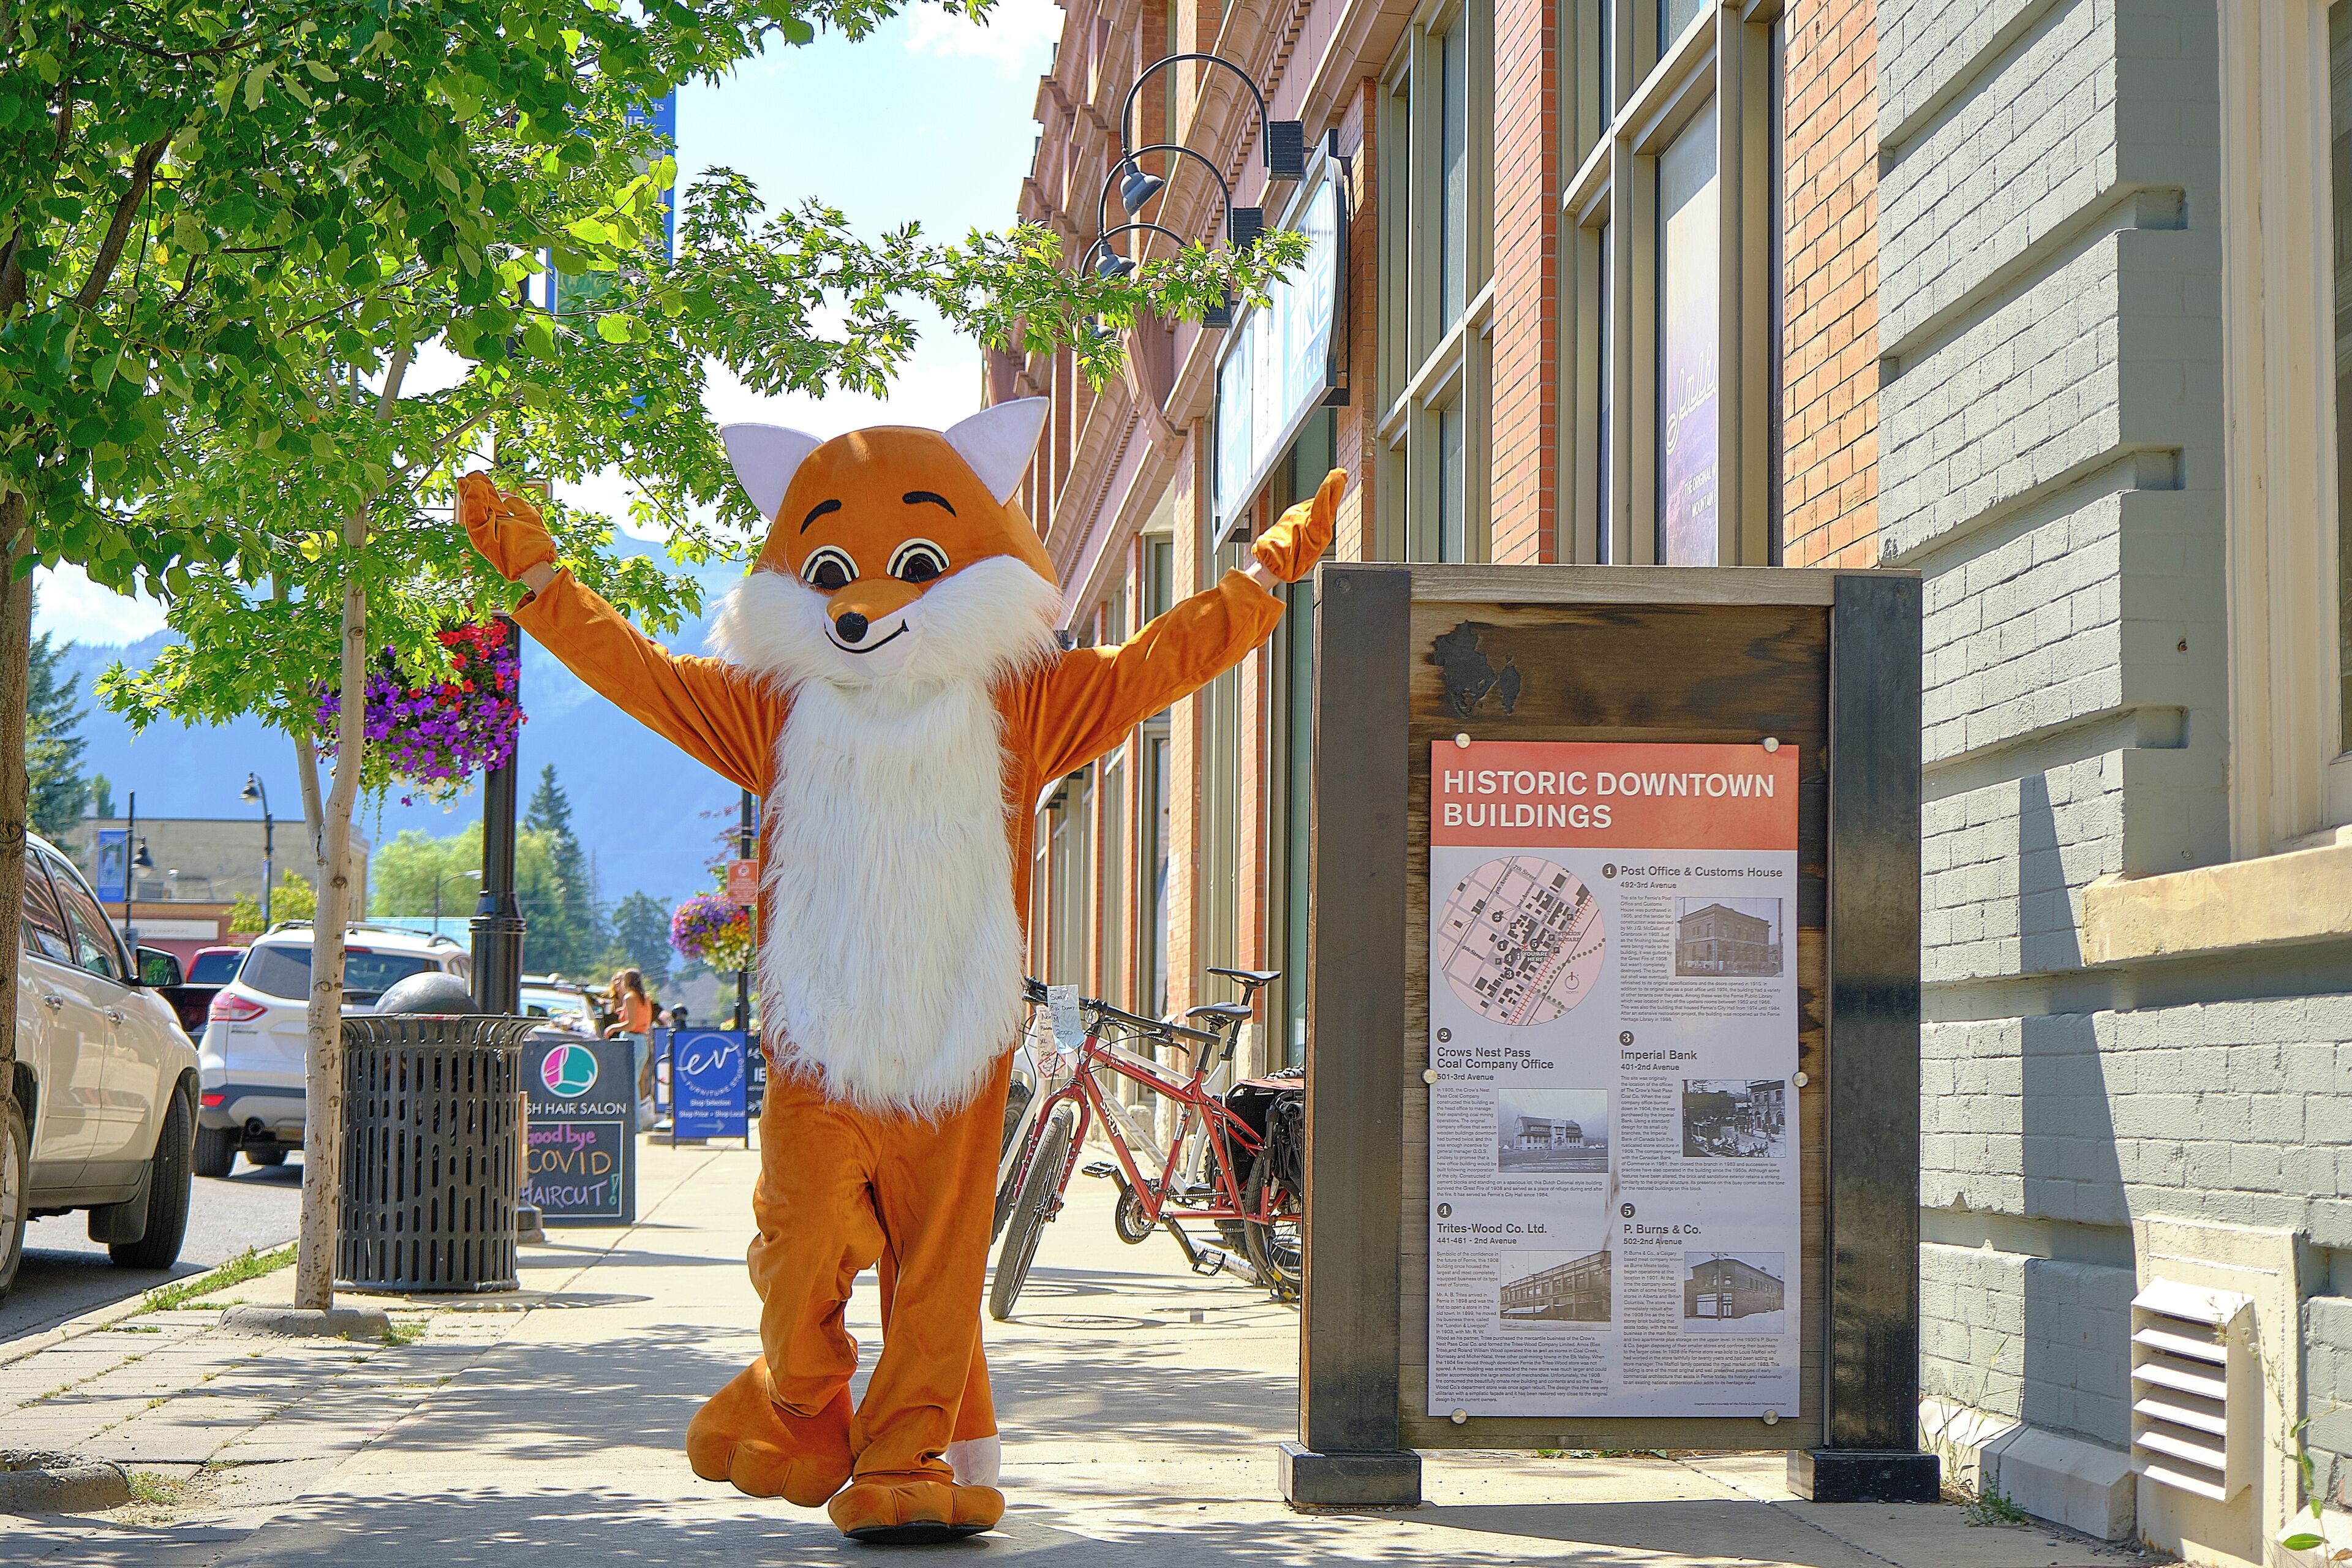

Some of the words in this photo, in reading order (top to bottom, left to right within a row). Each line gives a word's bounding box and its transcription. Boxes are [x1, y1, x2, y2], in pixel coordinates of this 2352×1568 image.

[1684, 480, 1693, 497] THE
[1692, 466, 1711, 492] ORIGINAL
[1691, 490, 1714, 518] MOUNTAIN
[1444, 770, 1588, 795] HISTORIC
[1597, 772, 1774, 797] DOWNTOWN
[1444, 803, 1611, 828] BUILDINGS
[1501, 868, 1513, 885] Avenue
[1523, 869, 1537, 881] Street
[1621, 866, 1645, 876] Post
[1649, 866, 1680, 876] Office
[1684, 867, 1692, 876] &
[1695, 867, 1744, 877] Customs
[1747, 867, 1782, 877] House
[1523, 882, 1535, 899] Avenue
[1547, 897, 1560, 913] Avenue
[1470, 949, 1485, 961] Street
[1437, 1047, 1472, 1057] Crows
[1476, 1047, 1501, 1057] Nest
[1504, 1047, 1531, 1057] Pass
[1621, 1049, 1665, 1061] Imperial
[1669, 1050, 1697, 1060] Bank
[729, 1057, 745, 1088] STUDIO
[1437, 1058, 1462, 1068] Coal
[1465, 1058, 1518, 1071] Company
[1521, 1059, 1554, 1069] Office
[685, 1079, 731, 1096] FURNITURE
[545, 1102, 577, 1115] HAIR
[579, 1102, 627, 1115] SALON
[690, 1099, 705, 1107] Shop
[1099, 1100, 1121, 1138] SURLY
[565, 1124, 597, 1152] bye
[527, 1149, 612, 1176] COVID
[1023, 1136, 1039, 1172] SURLY
[1061, 1147, 1077, 1183] SURLY
[1437, 1223, 1502, 1233] Trites-Wood
[1506, 1224, 1524, 1233] Co.
[1528, 1224, 1547, 1234] Ltd.
[1624, 1224, 1633, 1234] P.
[1636, 1224, 1669, 1234] Burns
[1672, 1225, 1680, 1234] &
[1683, 1224, 1702, 1234] Co.
